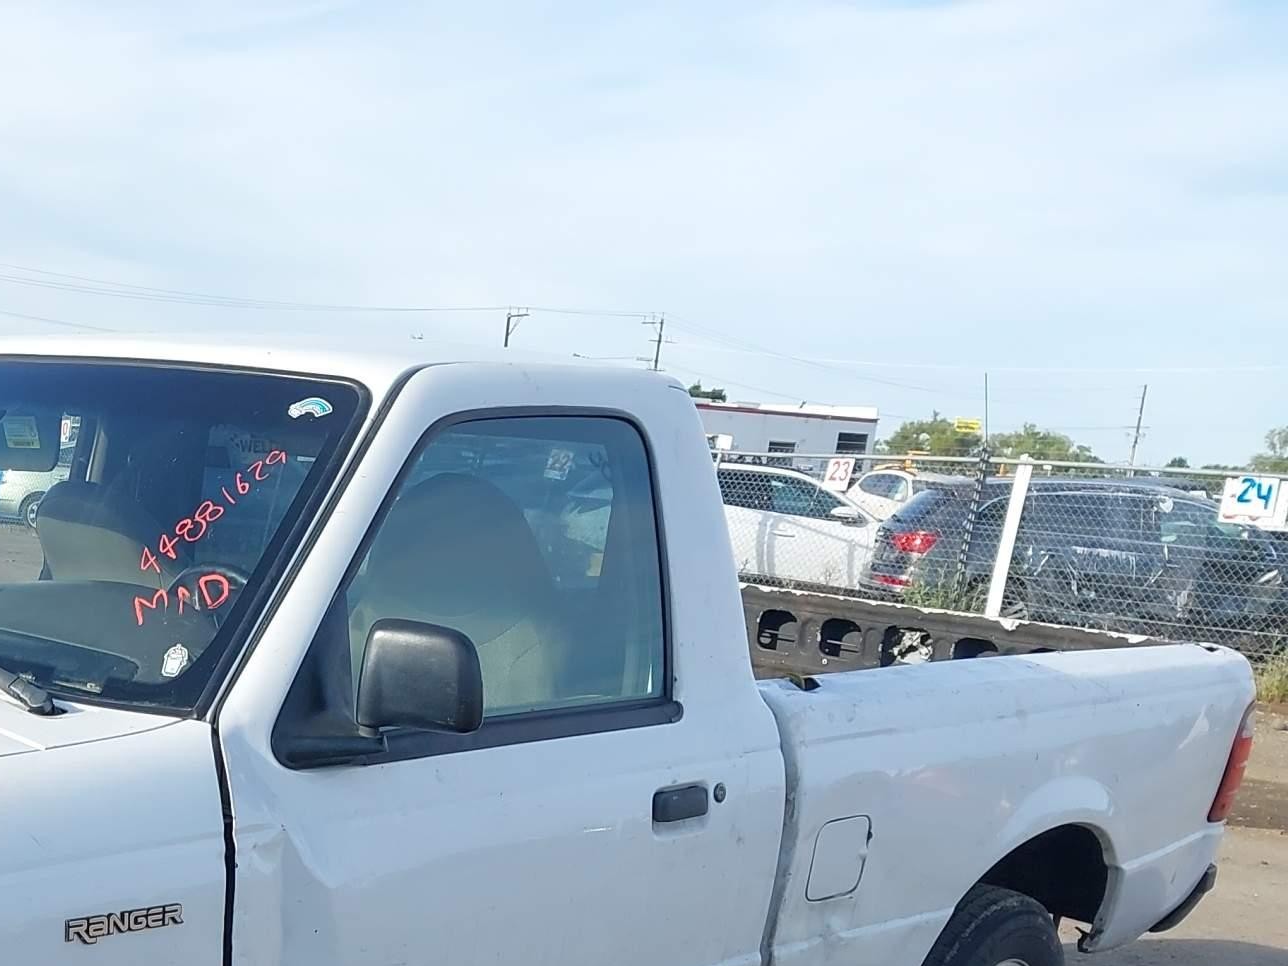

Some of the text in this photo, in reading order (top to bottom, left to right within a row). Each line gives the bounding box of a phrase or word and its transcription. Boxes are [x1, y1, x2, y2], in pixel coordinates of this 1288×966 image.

[828, 460, 850, 481] 23
[139, 449, 288, 574] 44881629
[1237, 478, 1273, 510] 24
[64, 902, 184, 945] RANGER
